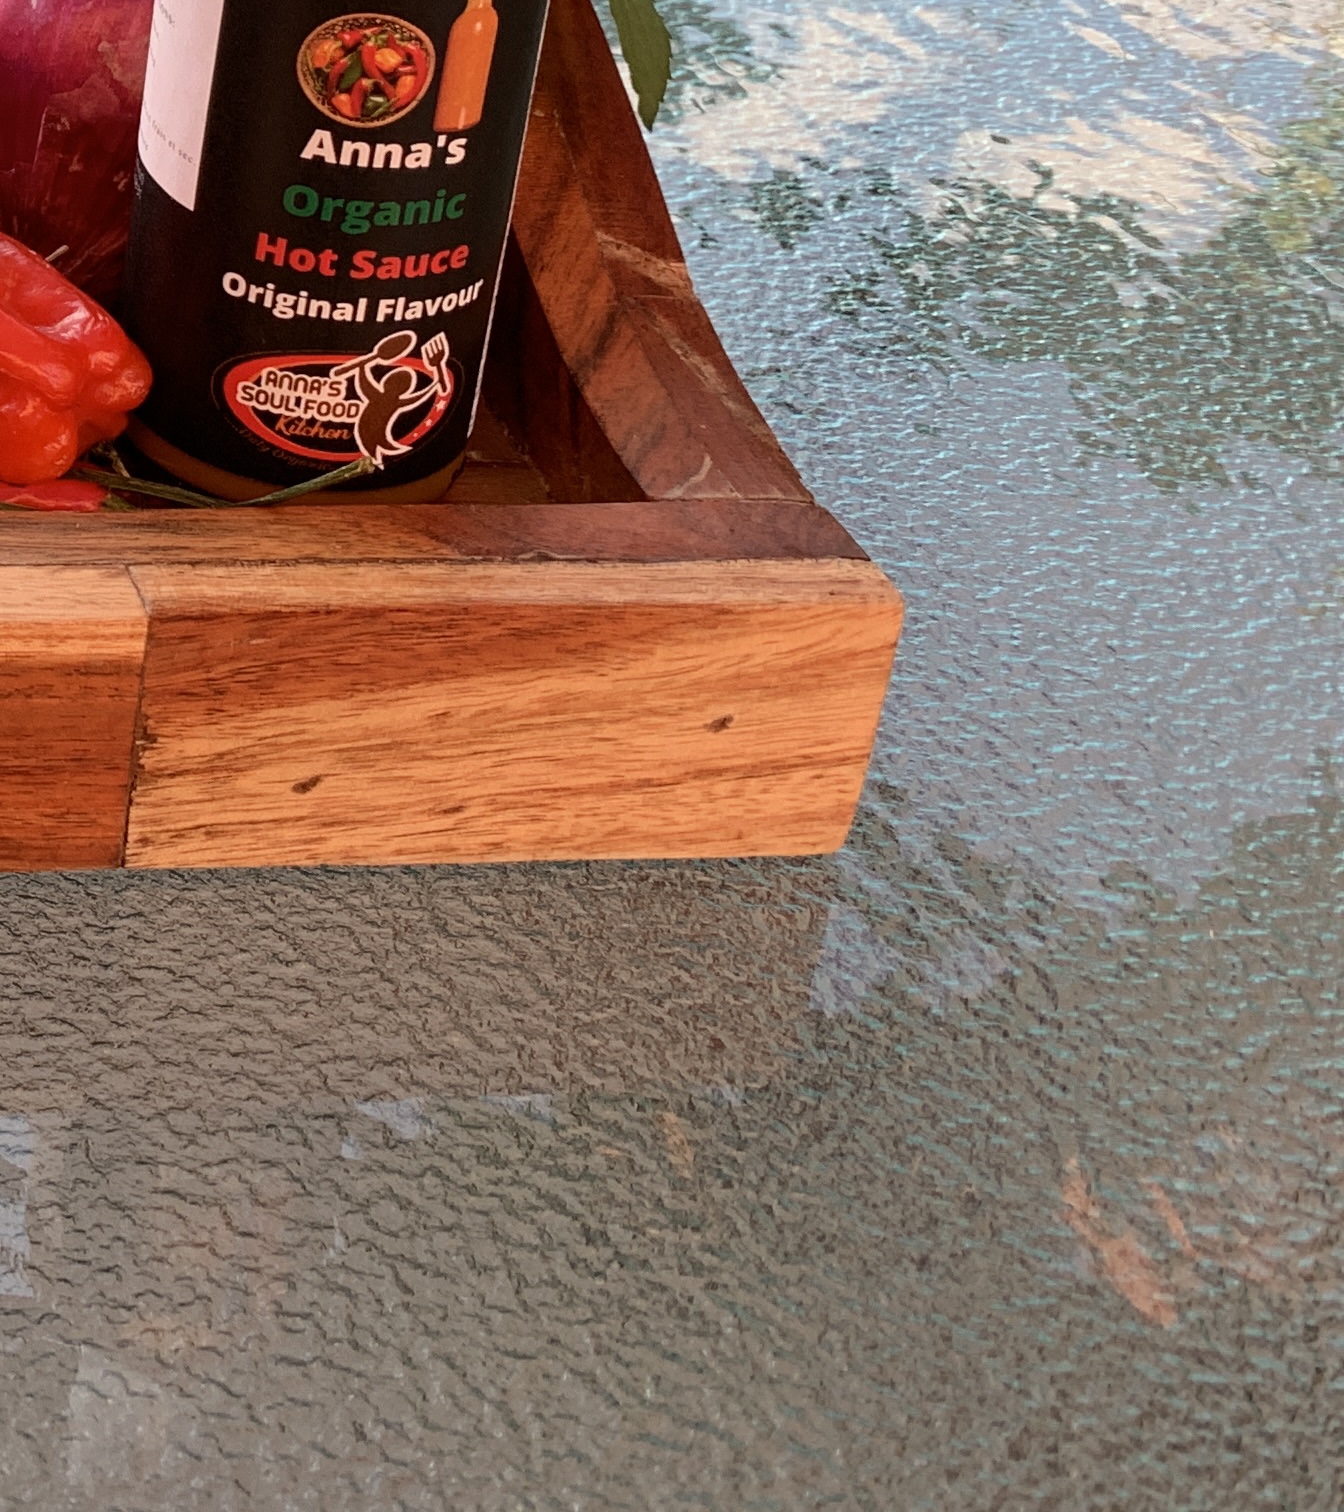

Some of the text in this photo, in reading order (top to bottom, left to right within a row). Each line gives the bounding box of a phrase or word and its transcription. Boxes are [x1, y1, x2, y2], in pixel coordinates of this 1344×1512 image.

[300, 129, 468, 169] Anna's
[282, 184, 467, 235] Organic
[255, 232, 470, 280] Hot Sauce
[222, 271, 484, 322] Original Flavour
[240, 384, 361, 419] SOUL FOOD
[265, 370, 343, 397] ANNA'S
[275, 415, 353, 440] Kitchen
